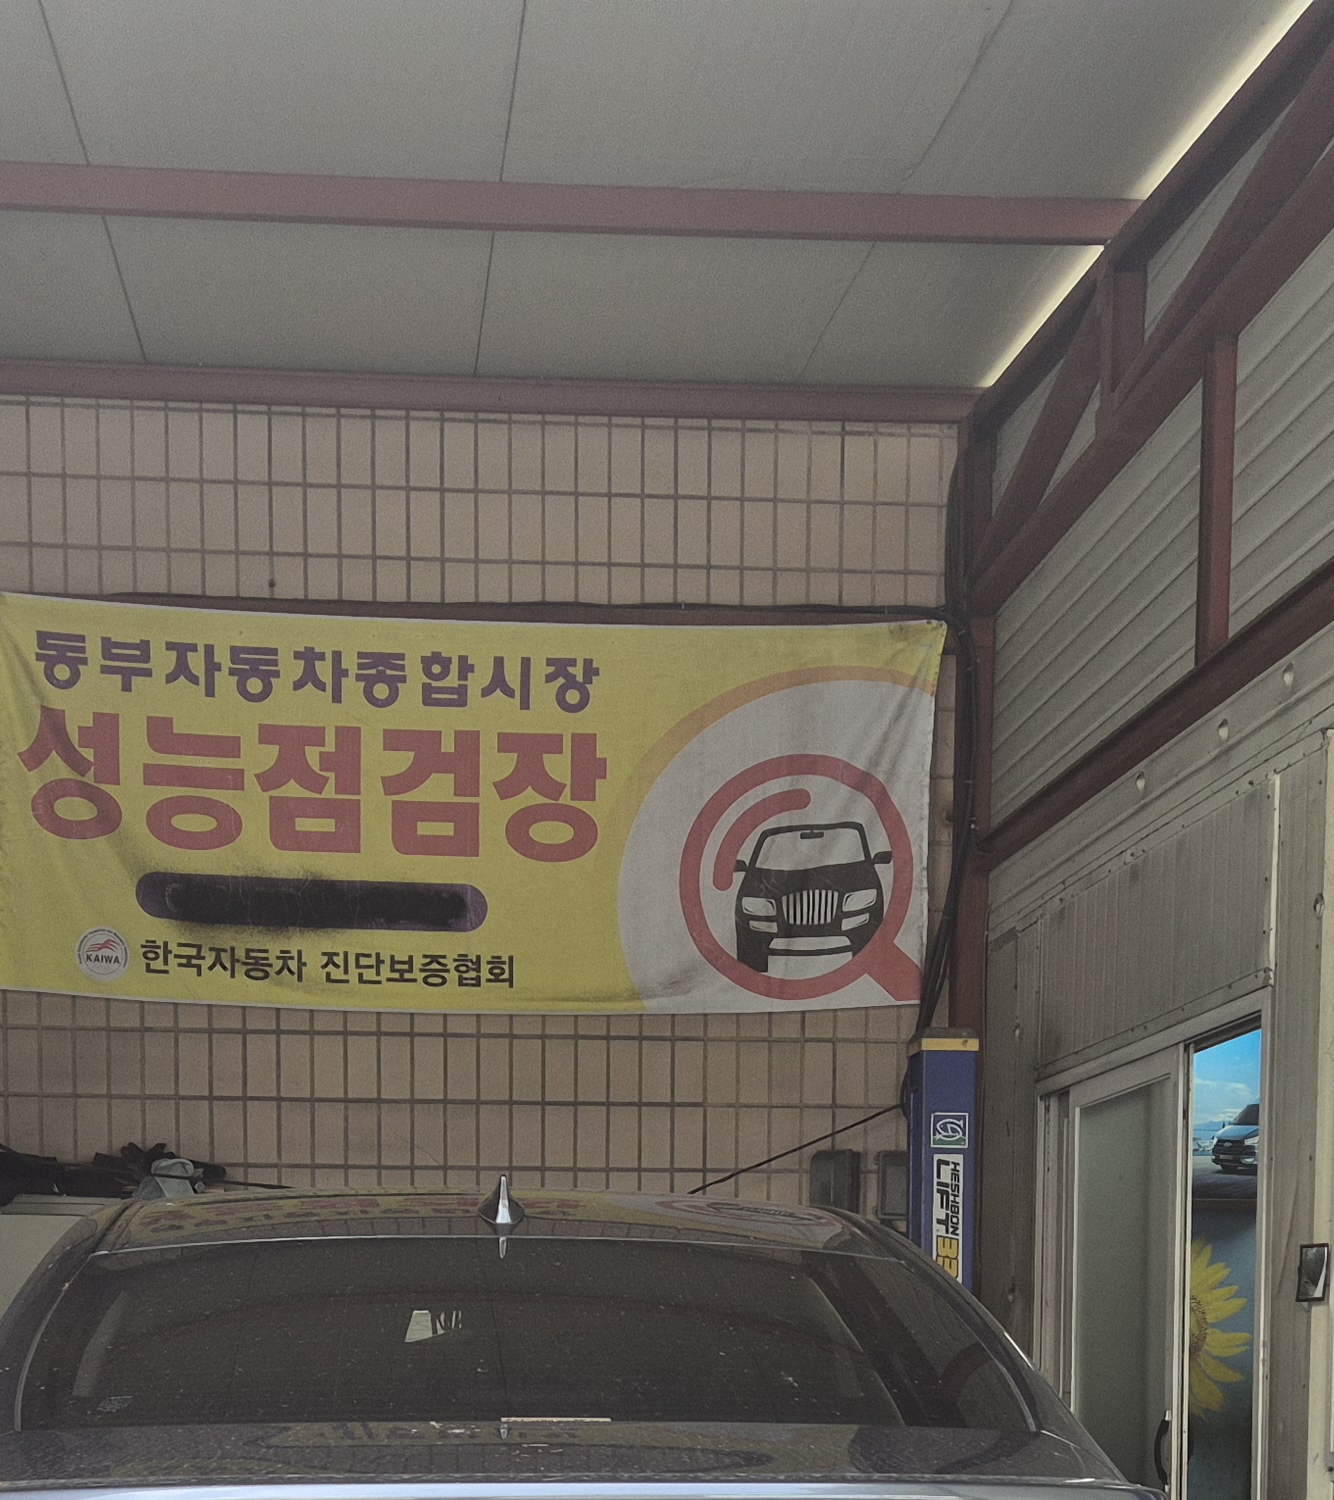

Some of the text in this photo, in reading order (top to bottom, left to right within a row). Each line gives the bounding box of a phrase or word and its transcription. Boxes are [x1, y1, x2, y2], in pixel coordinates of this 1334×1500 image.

[35, 630, 600, 713] 동부자동차종합시장
[17, 703, 608, 861] 성능점검장
[85, 953, 121, 965] KAIWA
[141, 938, 306, 984] 한국자동차
[319, 945, 516, 989] 진단보증협회
[936, 1158, 950, 1235] LIFT
[950, 1161, 961, 1237] HESHBON
